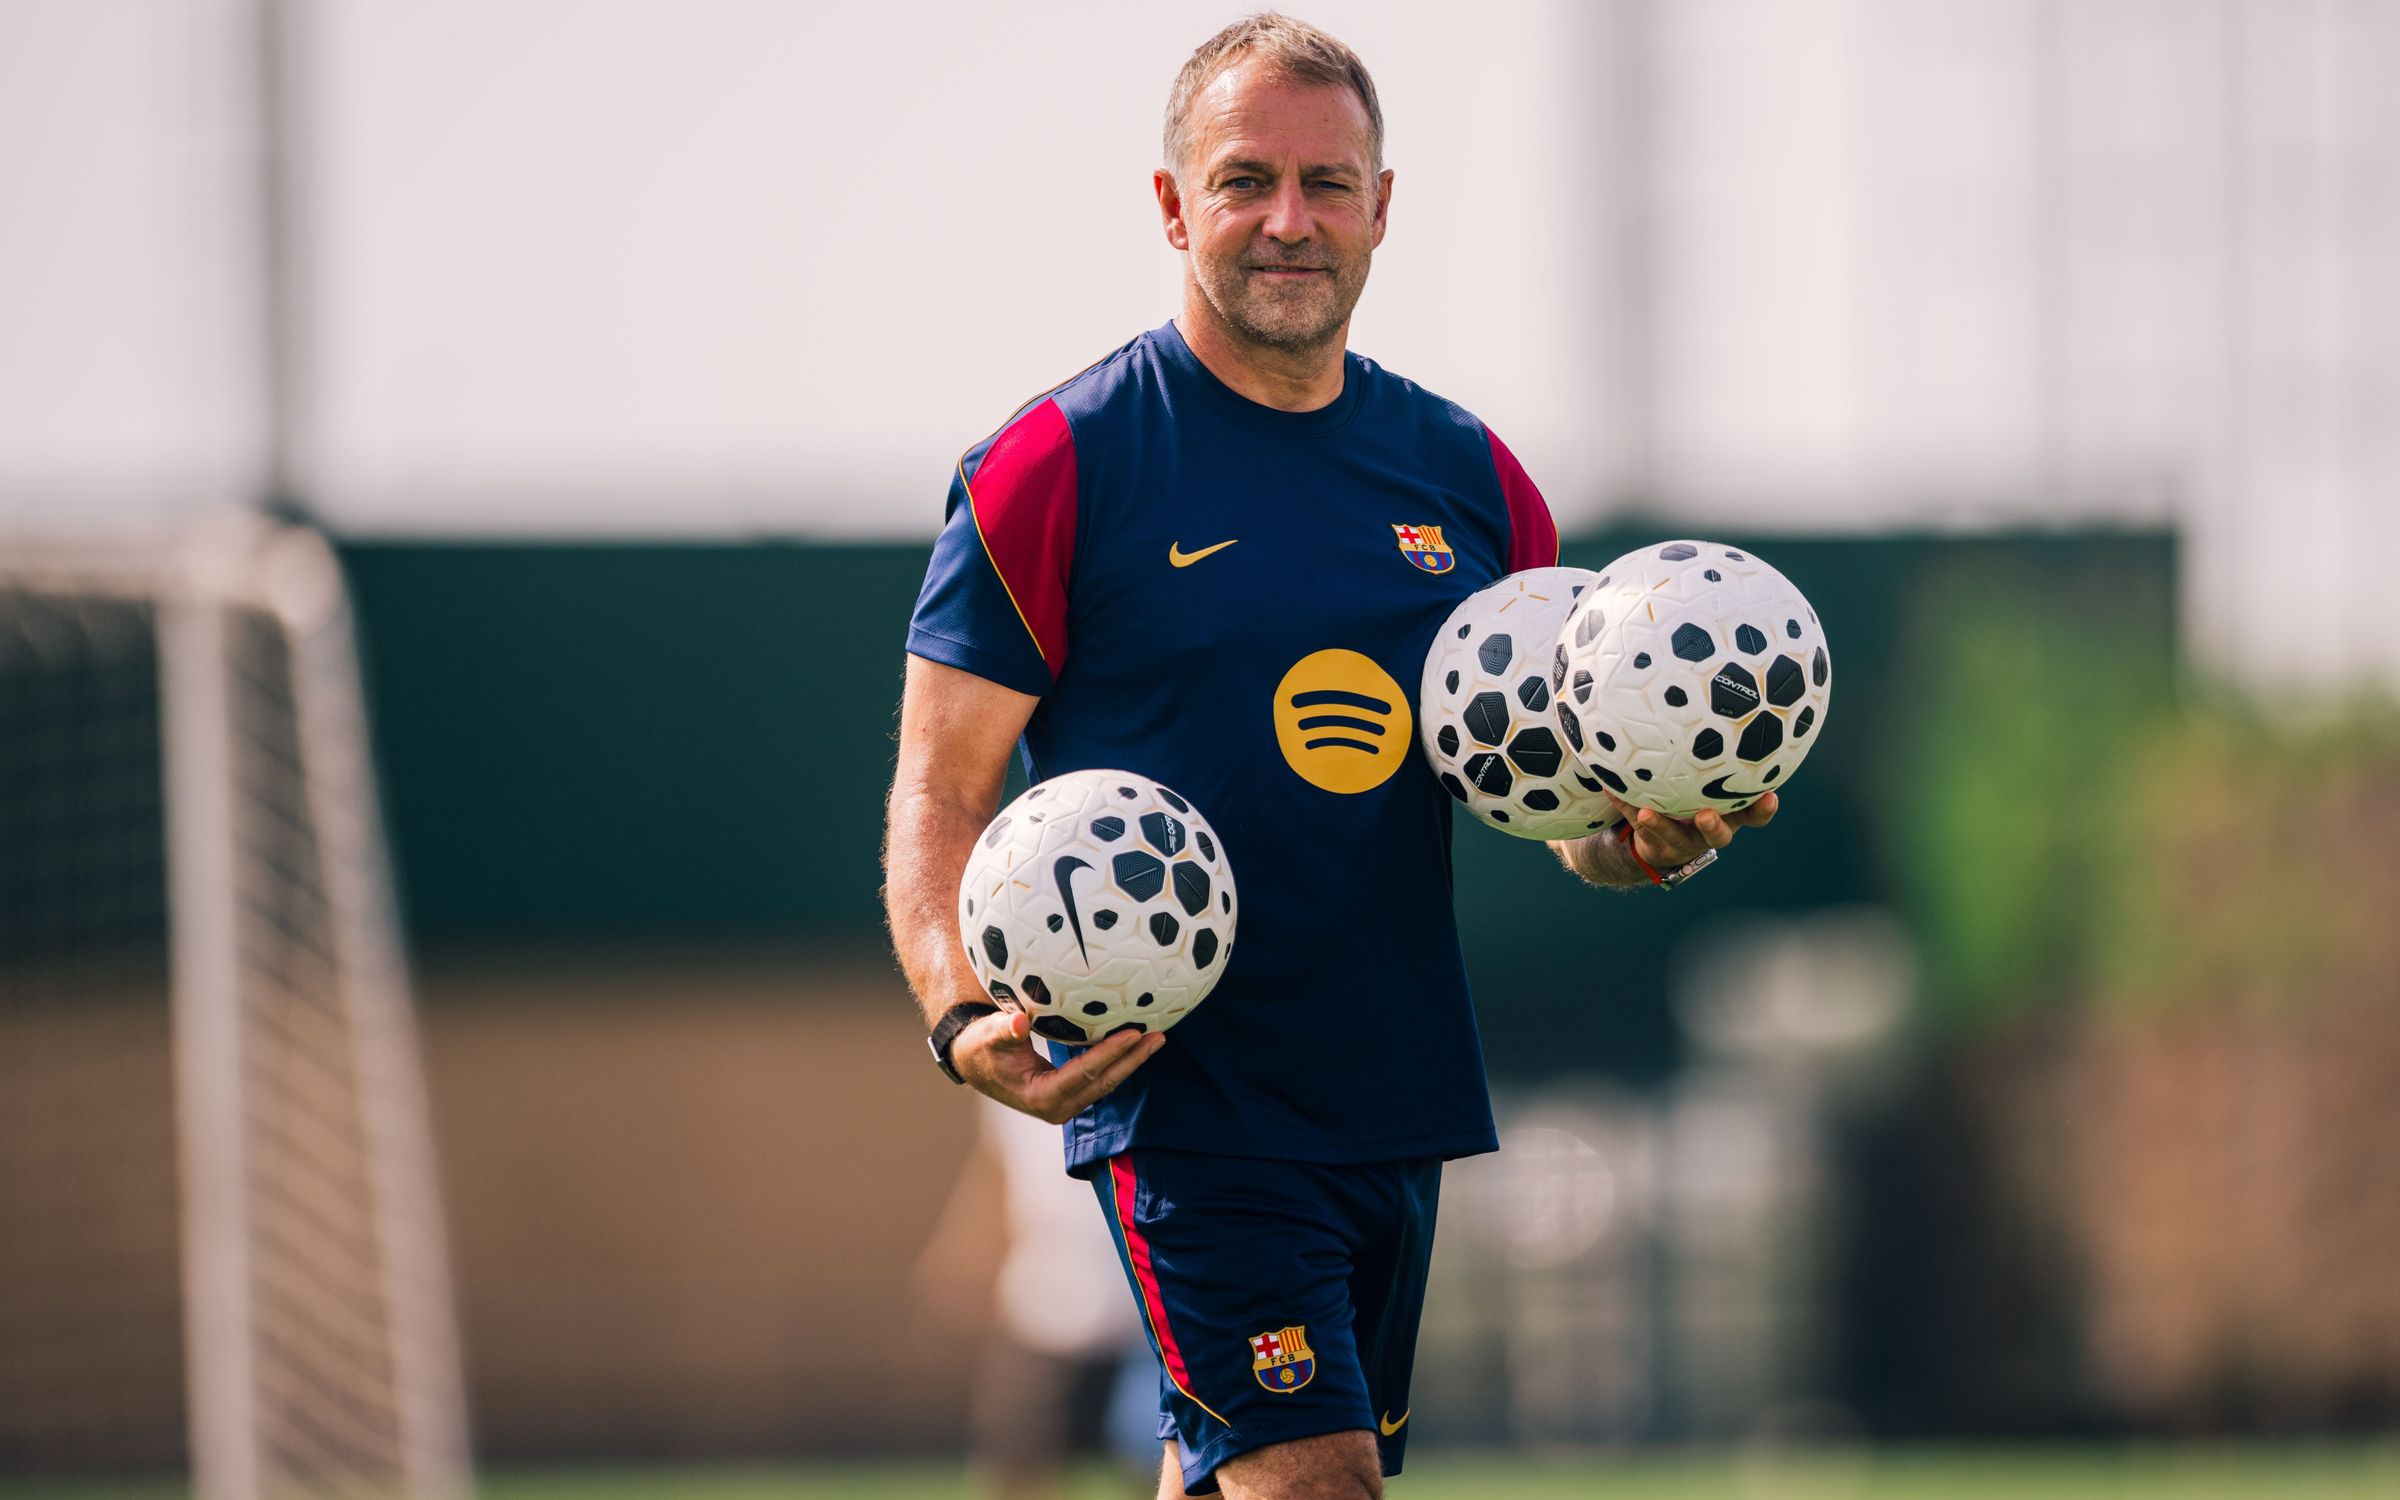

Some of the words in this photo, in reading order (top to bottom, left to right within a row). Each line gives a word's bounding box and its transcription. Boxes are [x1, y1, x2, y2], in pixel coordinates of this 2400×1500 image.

[1714, 675, 1759, 700] CONTROL
[1474, 754, 1496, 788] CONTROL
[1270, 1353, 1296, 1366] FCB
